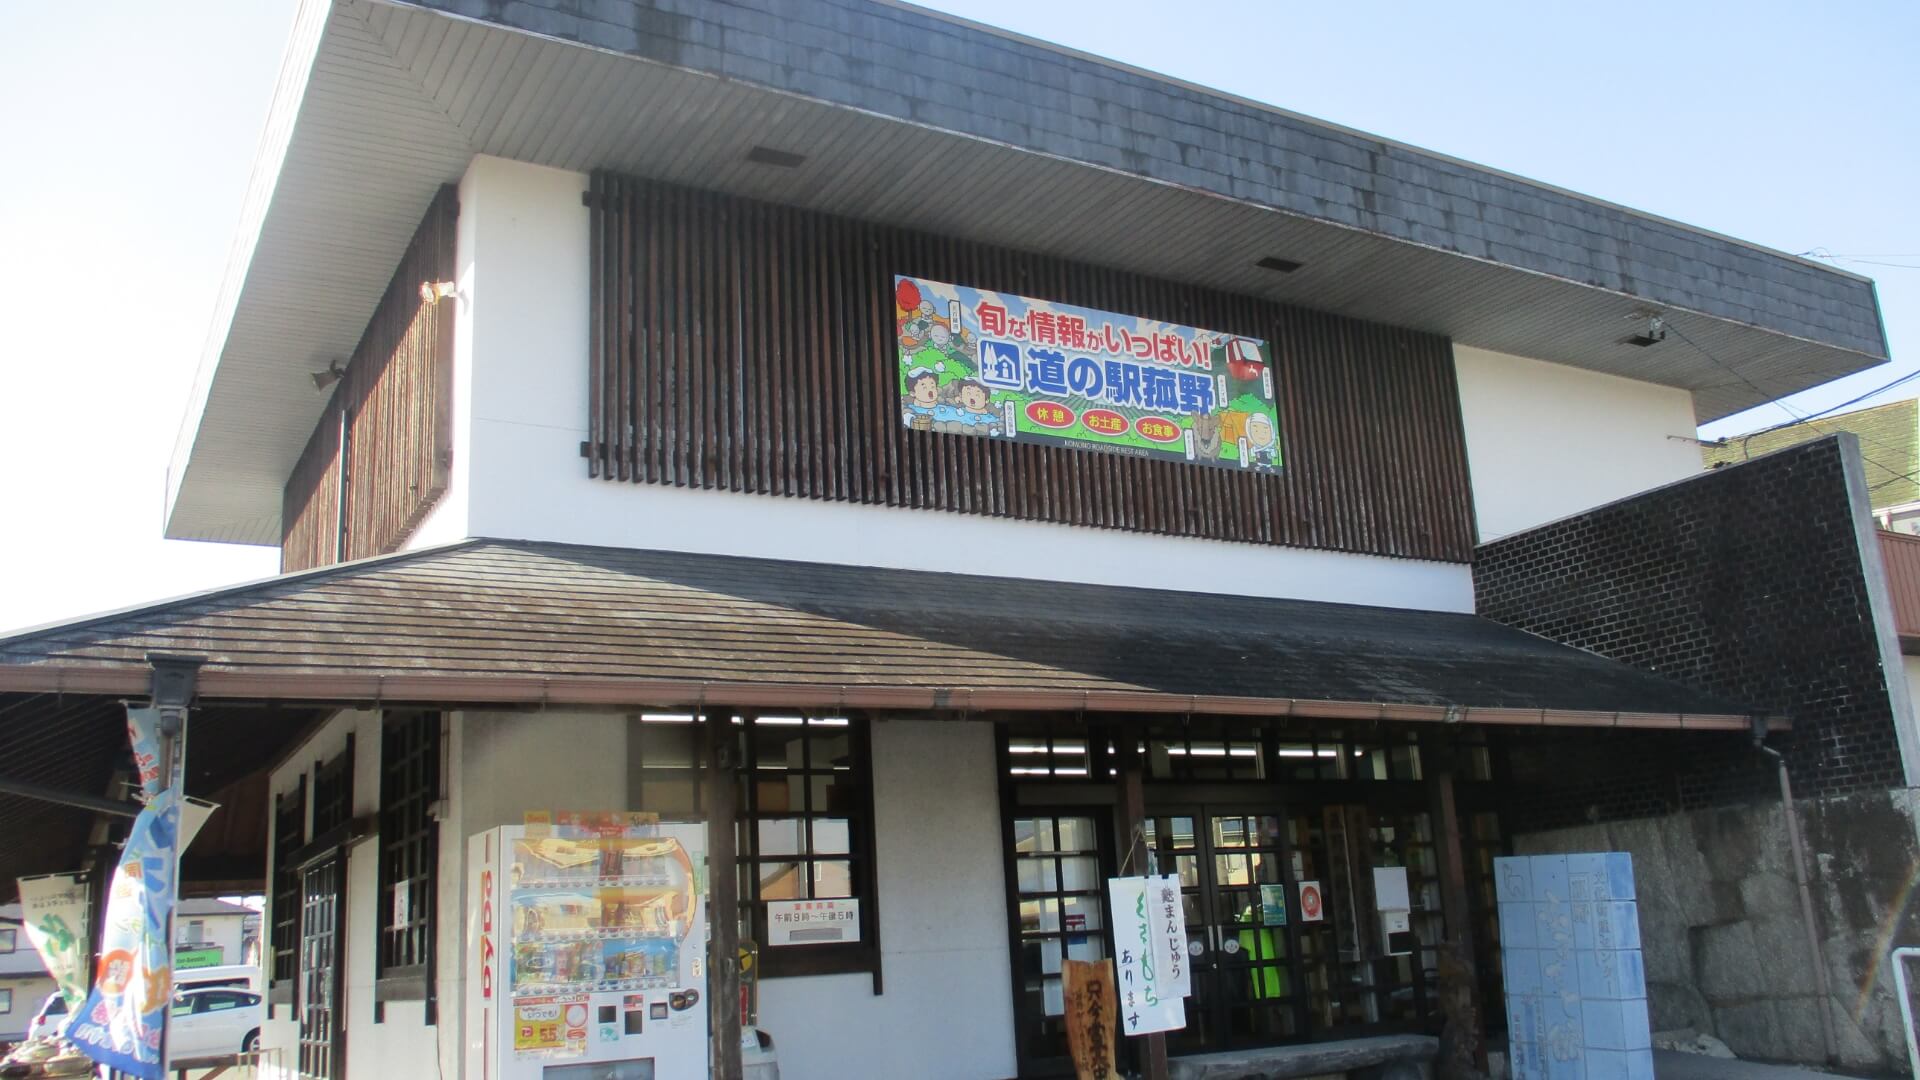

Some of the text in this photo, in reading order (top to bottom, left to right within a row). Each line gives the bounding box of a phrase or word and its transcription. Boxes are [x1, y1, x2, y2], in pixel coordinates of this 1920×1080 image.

[1027, 349, 1214, 414] 道の駅菰野
[1037, 407, 1065, 424] 休憩
[1088, 414, 1123, 432] お土産
[1141, 421, 1175, 438] お食事
[1135, 891, 1158, 1007] くさもち
[1121, 948, 1141, 1030] あります
